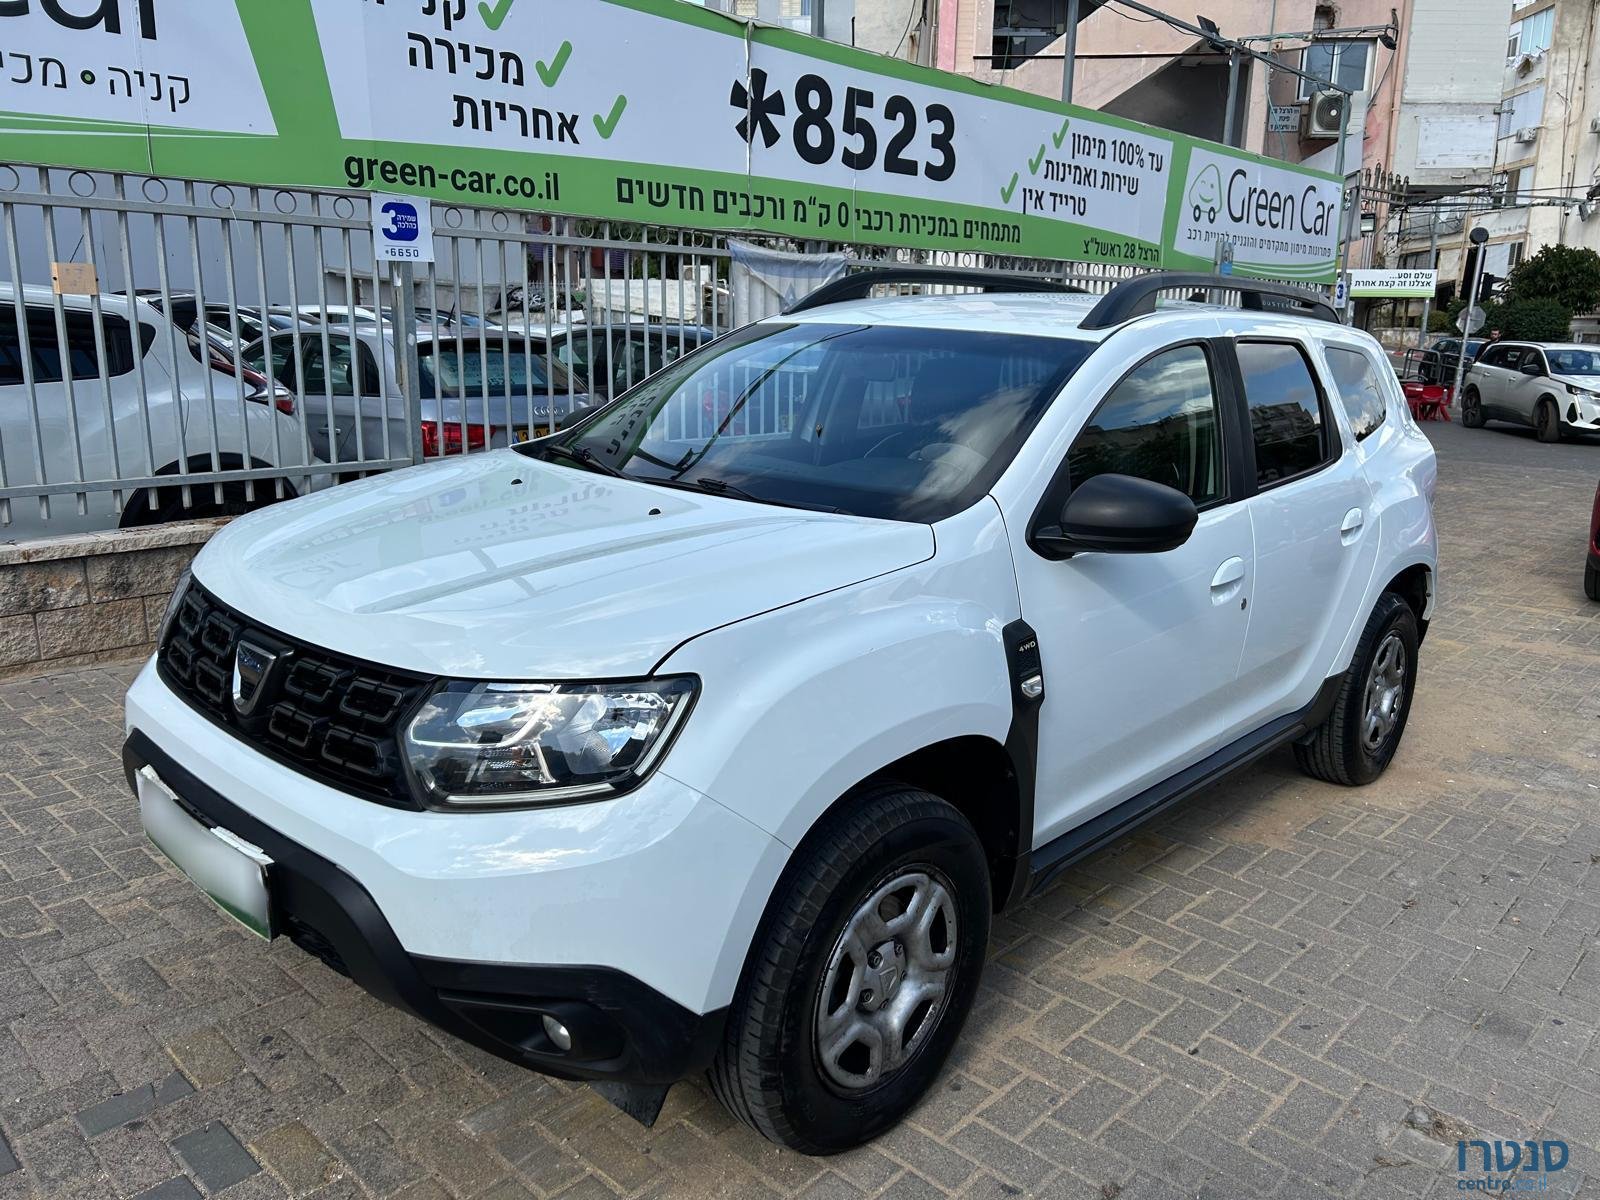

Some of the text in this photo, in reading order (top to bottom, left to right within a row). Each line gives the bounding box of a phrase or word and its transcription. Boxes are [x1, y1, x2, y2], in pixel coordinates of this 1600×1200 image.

[408, 32, 524, 86] מכירה
[108, 66, 190, 112] קניה
[452, 94, 580, 144] אחריות
[1072, 133, 1163, 172] עד 100% מימון
[344, 156, 560, 200] green-car.co.il
[1044, 160, 1139, 195] שירות ואמינות
[617, 177, 704, 212] חדשים
[714, 189, 785, 220] ורכבים
[1022, 188, 1087, 216] טרייד אין
[1227, 169, 1334, 237] Green Car
[838, 202, 849, 227] 0
[855, 208, 893, 232] רכבי
[899, 213, 958, 237] במכירת
[963, 219, 1020, 243] מתמחים
[1187, 228, 1201, 240] רכב
[1124, 243, 1136, 259] 28
[1137, 243, 1159, 262] הרצל
[1259, 239, 1289, 254] מתקדמים
[1290, 243, 1306, 256] מימון
[1307, 245, 1331, 257] פתרונות
[1378, 280, 1395, 288] קצת
[1019, 641, 1036, 652] 4WD
